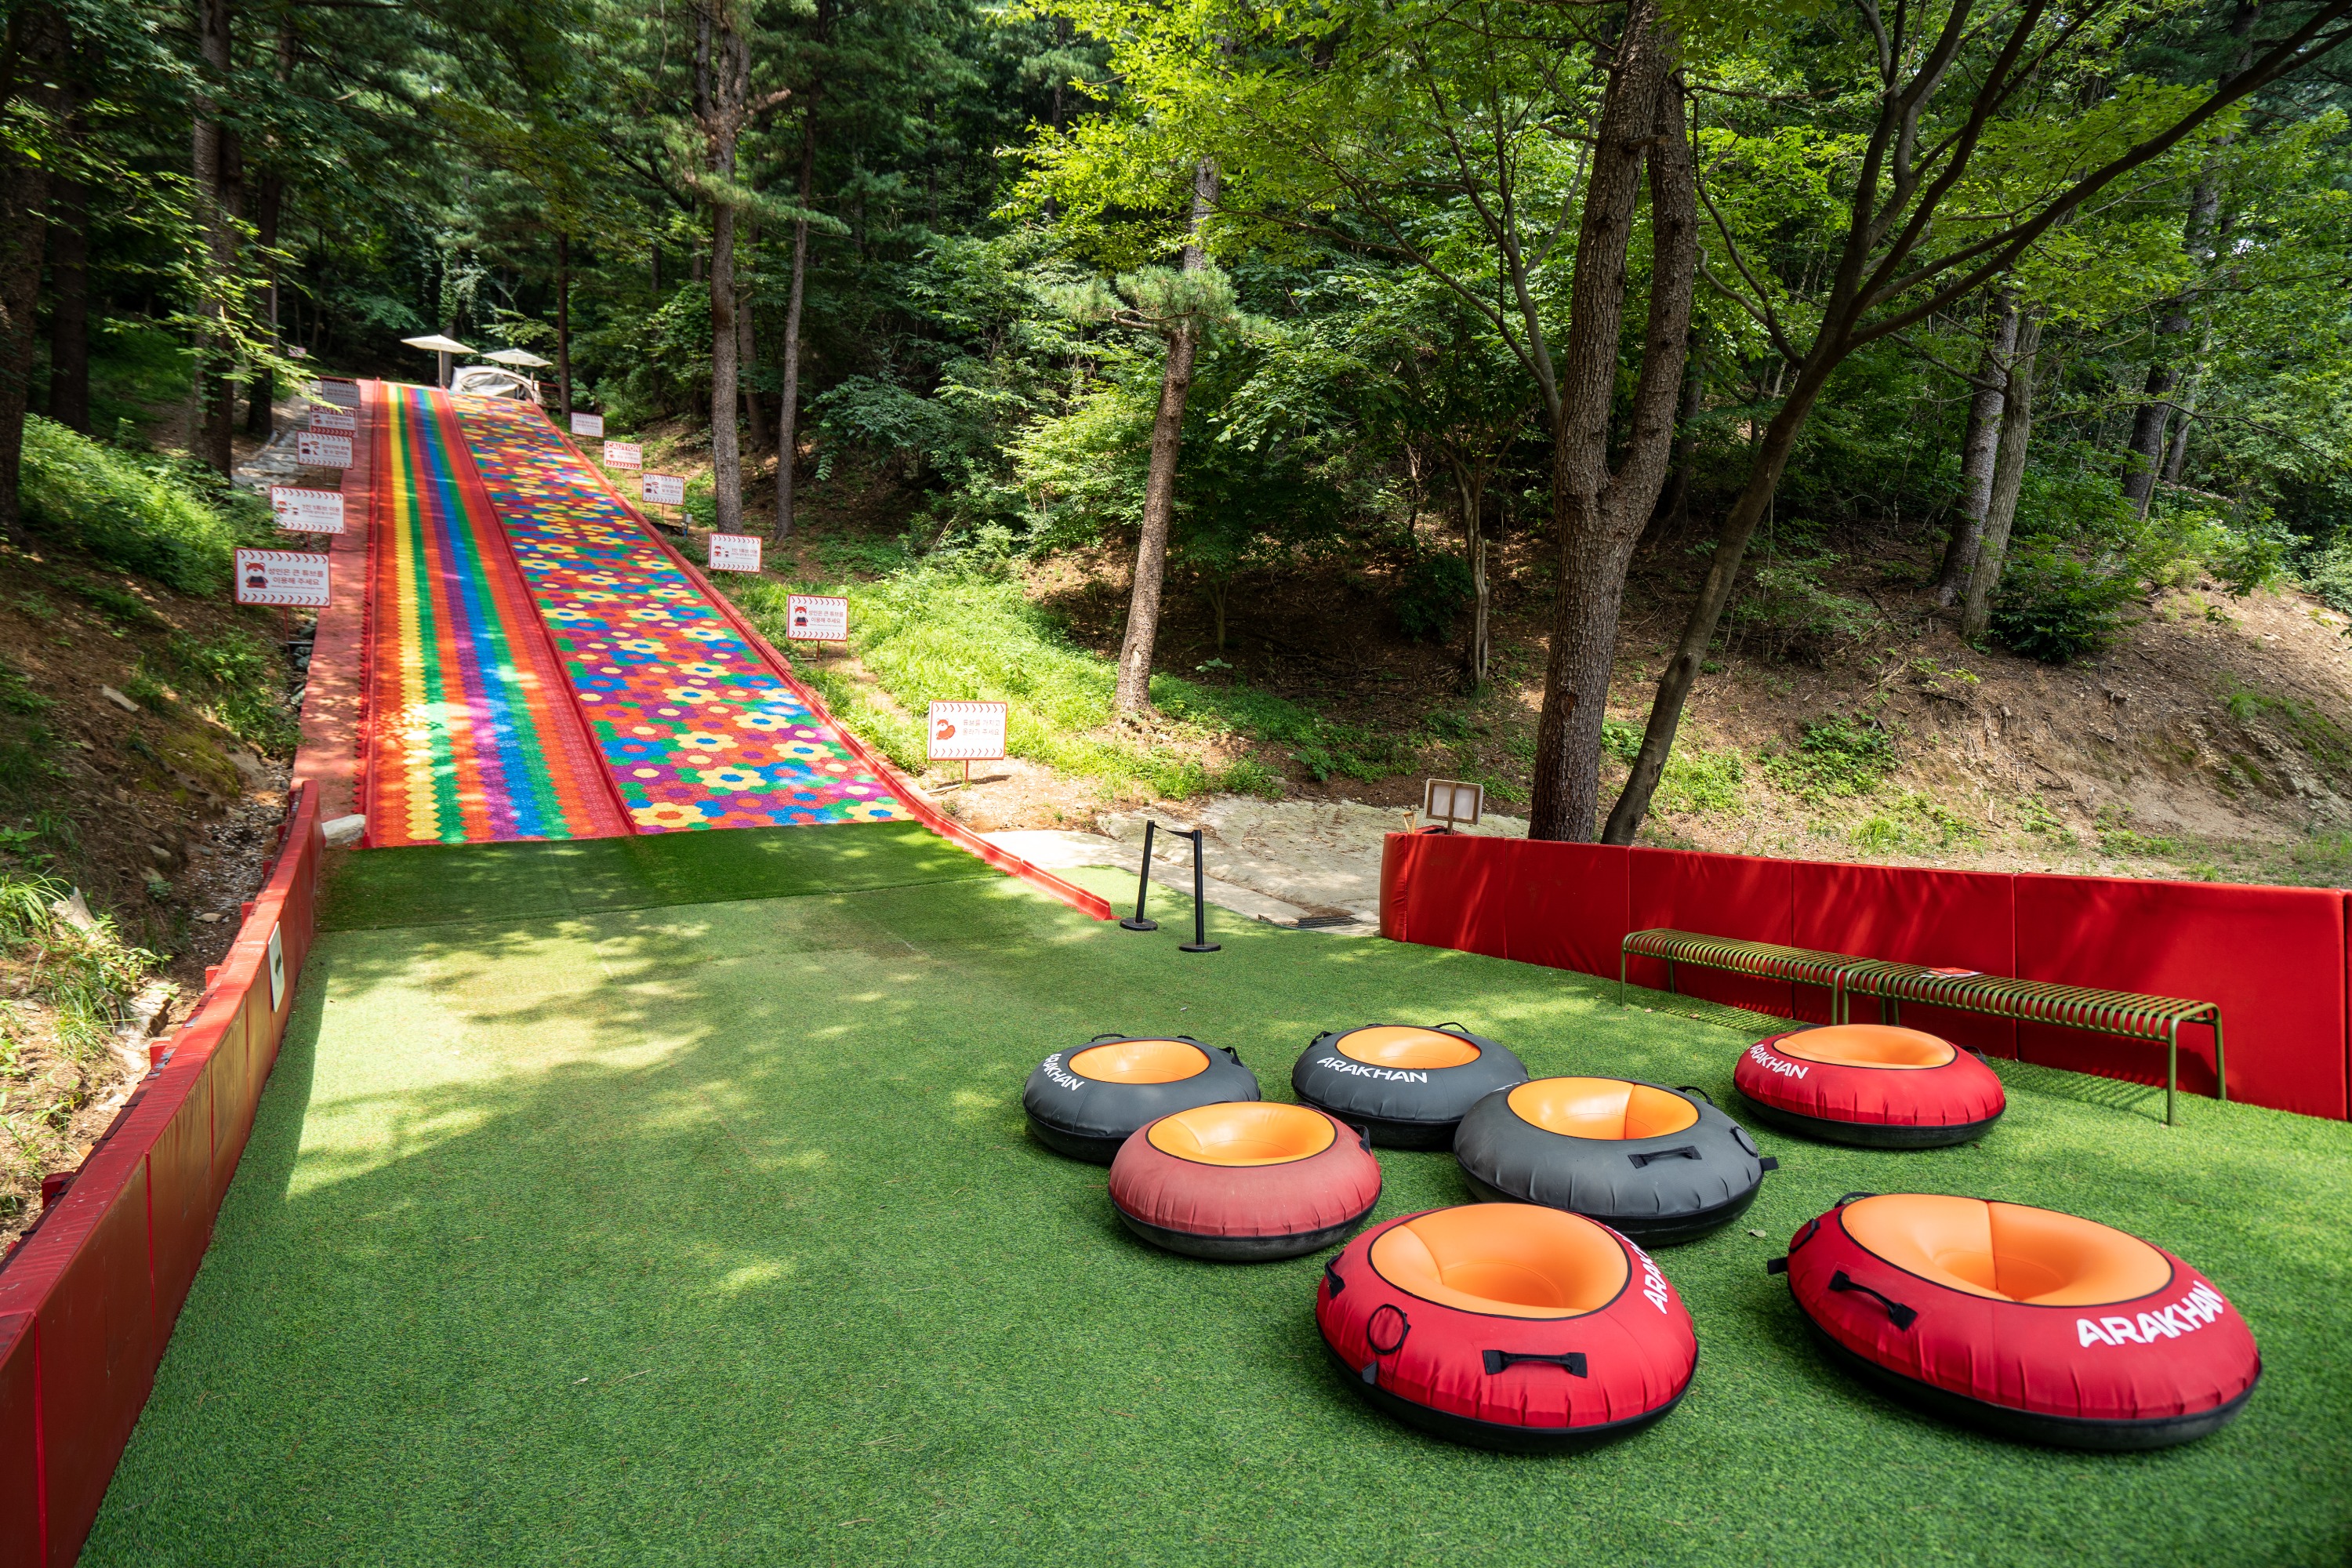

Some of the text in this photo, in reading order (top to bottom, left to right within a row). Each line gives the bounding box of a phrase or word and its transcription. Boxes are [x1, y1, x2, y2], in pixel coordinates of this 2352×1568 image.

[607, 442, 641, 452] CAUTION
[1043, 1053, 1085, 1091] ARAKHAN
[1316, 1057, 1428, 1083] ARAKHAN
[1750, 1044, 1809, 1080] ARAKHAN
[2076, 1279, 2223, 1348] ARAKHAN
